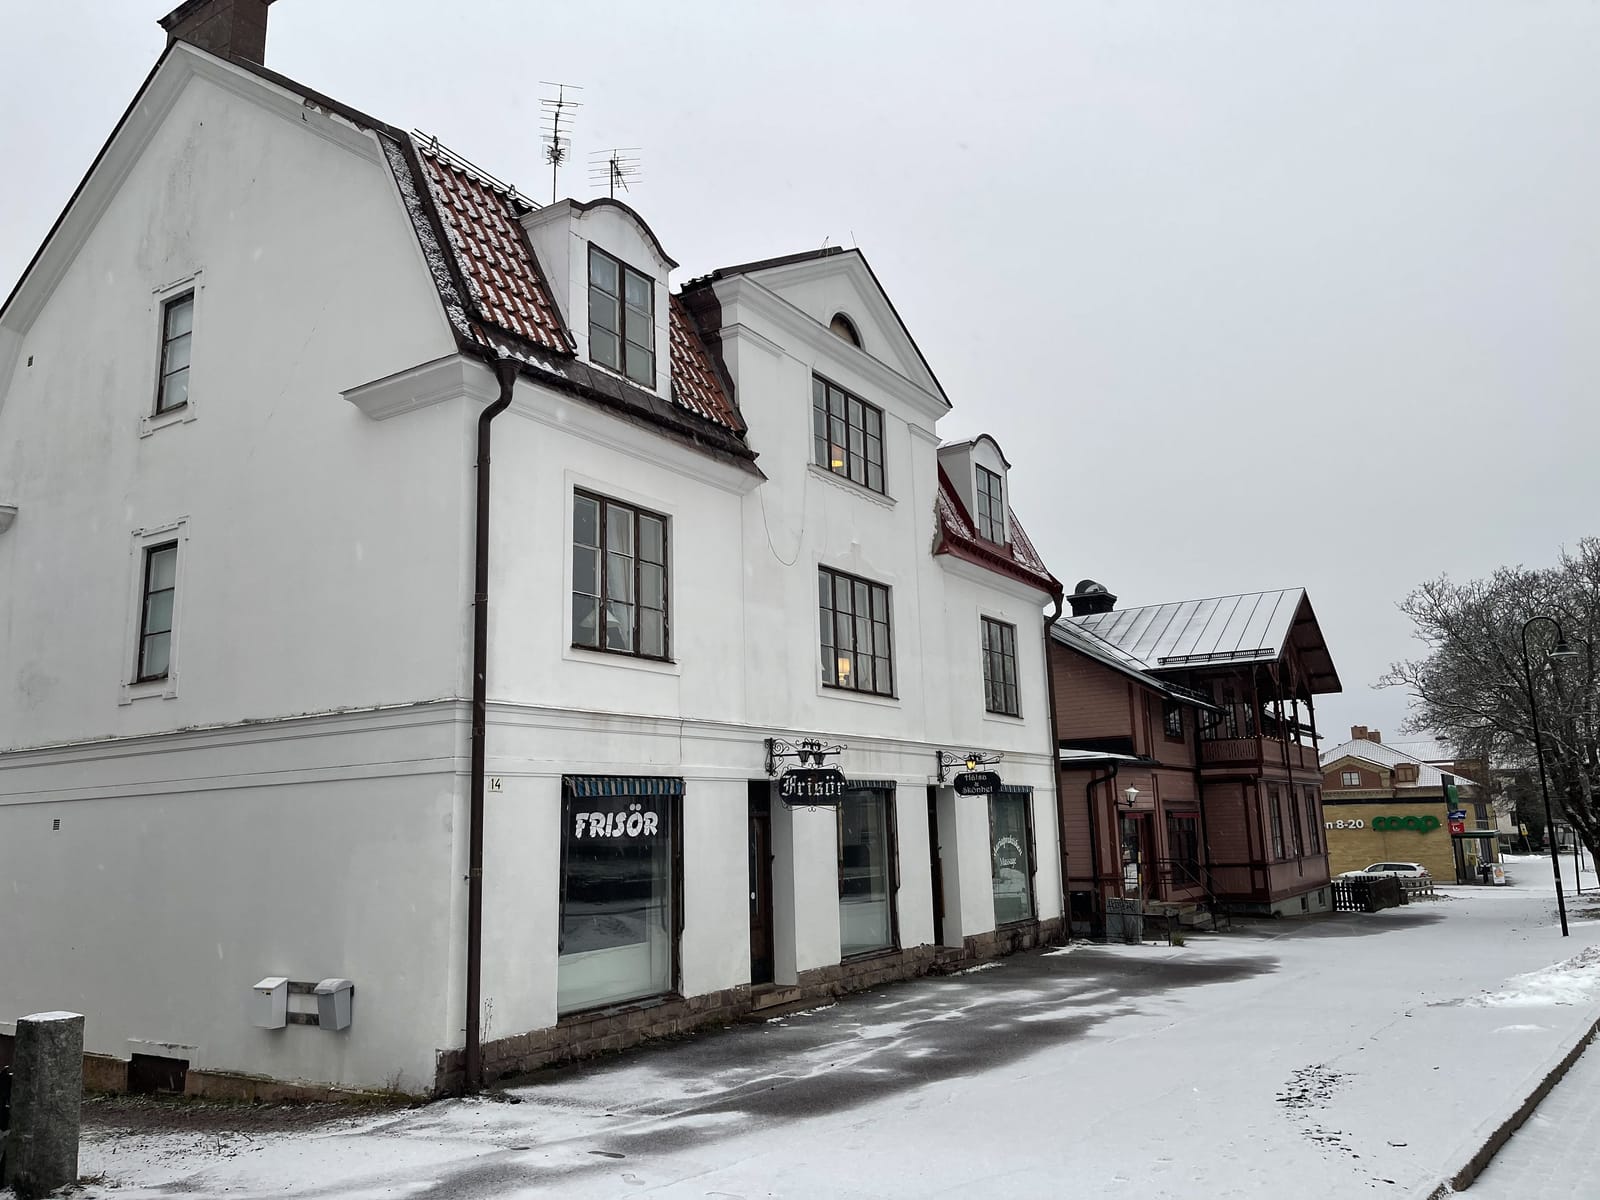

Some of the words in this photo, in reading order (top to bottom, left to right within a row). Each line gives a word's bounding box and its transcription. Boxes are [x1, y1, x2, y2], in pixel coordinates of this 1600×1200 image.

[490, 778, 501, 790] 14
[781, 775, 845, 797] Frisör
[575, 803, 659, 839] FRISÖR
[1336, 819, 1364, 829] 8-20
